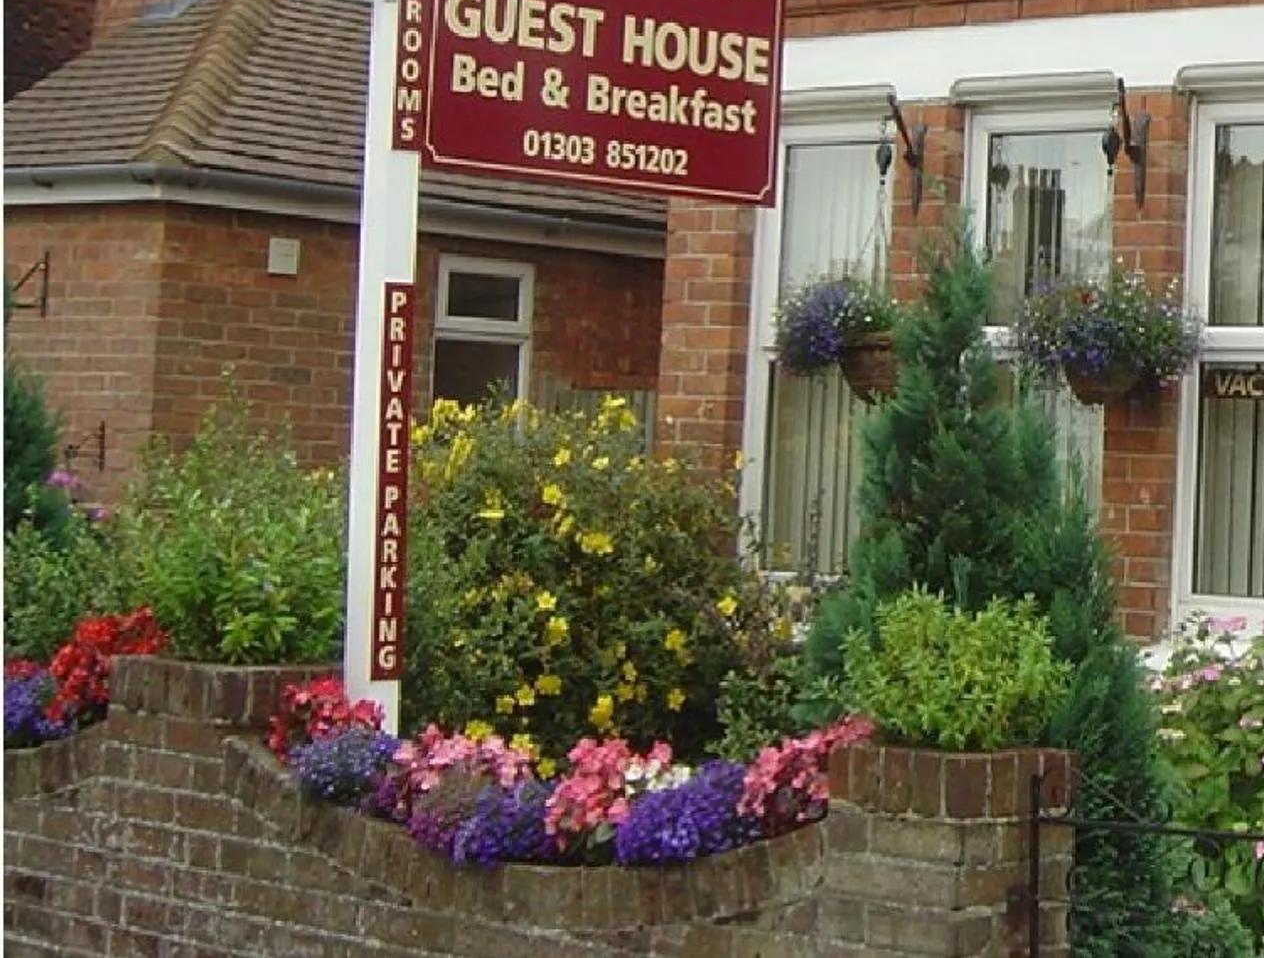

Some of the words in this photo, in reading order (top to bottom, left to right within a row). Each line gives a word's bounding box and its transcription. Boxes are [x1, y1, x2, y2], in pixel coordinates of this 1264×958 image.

[397, 0, 423, 141] ROOMS
[452, 53, 525, 102] Bed
[540, 67, 570, 110] &
[586, 73, 758, 135] Breakfast
[623, 13, 770, 86] HOUSE
[522, 129, 594, 165] 01303
[605, 140, 689, 176] 851202
[385, 291, 407, 473] PRIVATE
[378, 486, 401, 671] PARKING
